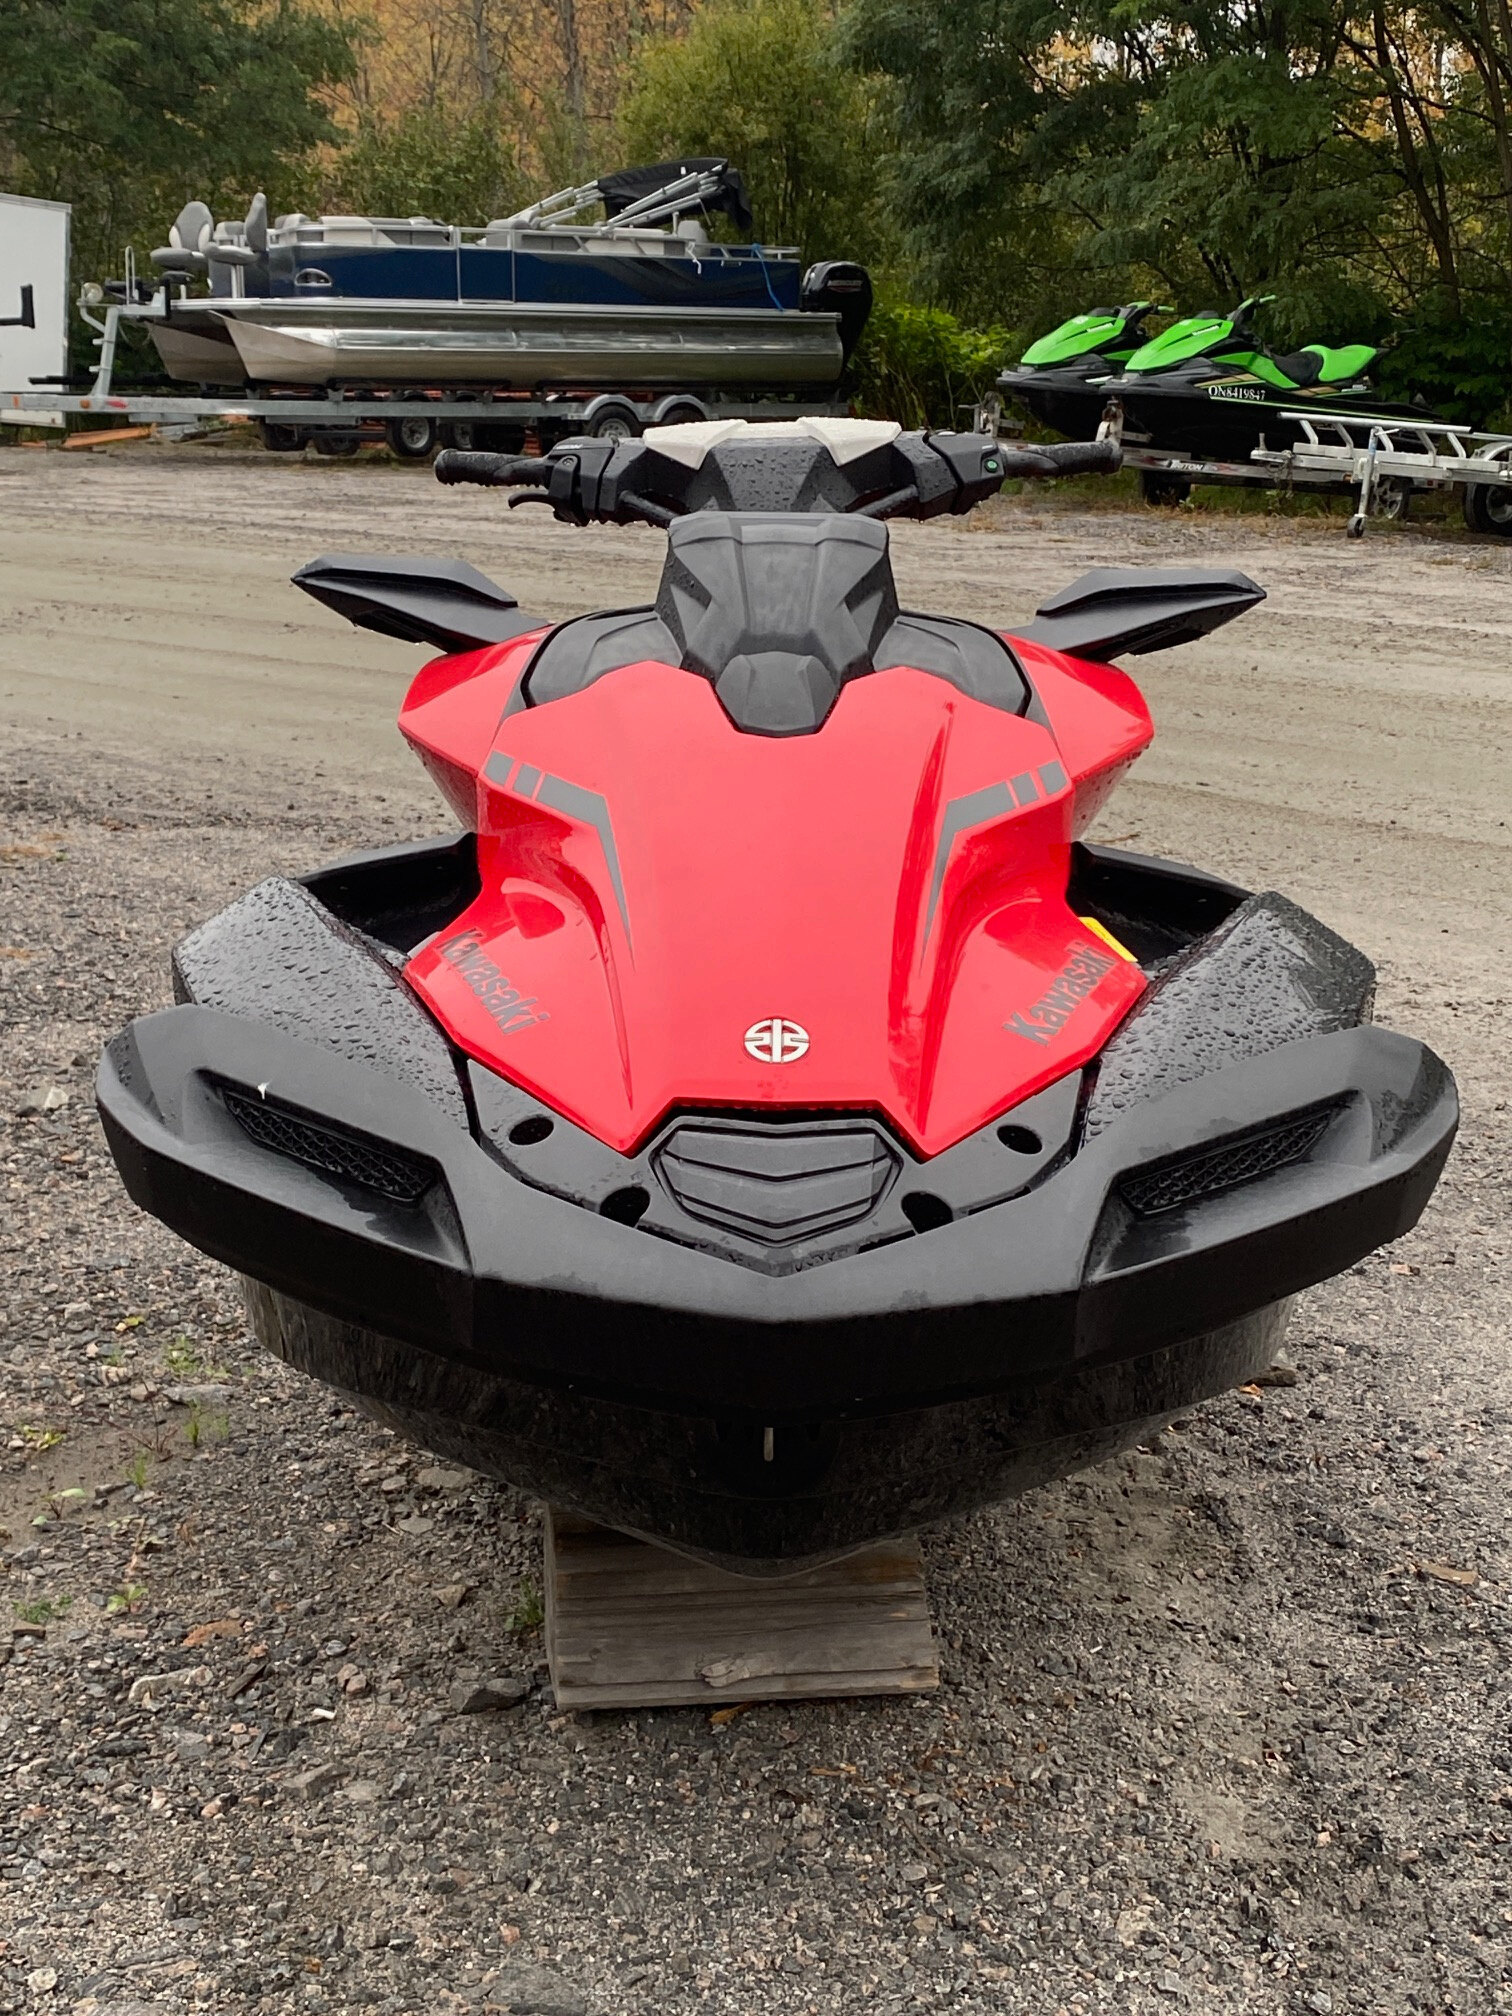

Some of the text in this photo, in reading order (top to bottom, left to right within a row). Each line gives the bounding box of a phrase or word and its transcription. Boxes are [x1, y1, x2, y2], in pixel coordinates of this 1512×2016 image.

[1208, 385, 1266, 400] ON8419847
[436, 927, 550, 1034] Kawasaki
[1003, 941, 1116, 1046] Kawasaki
